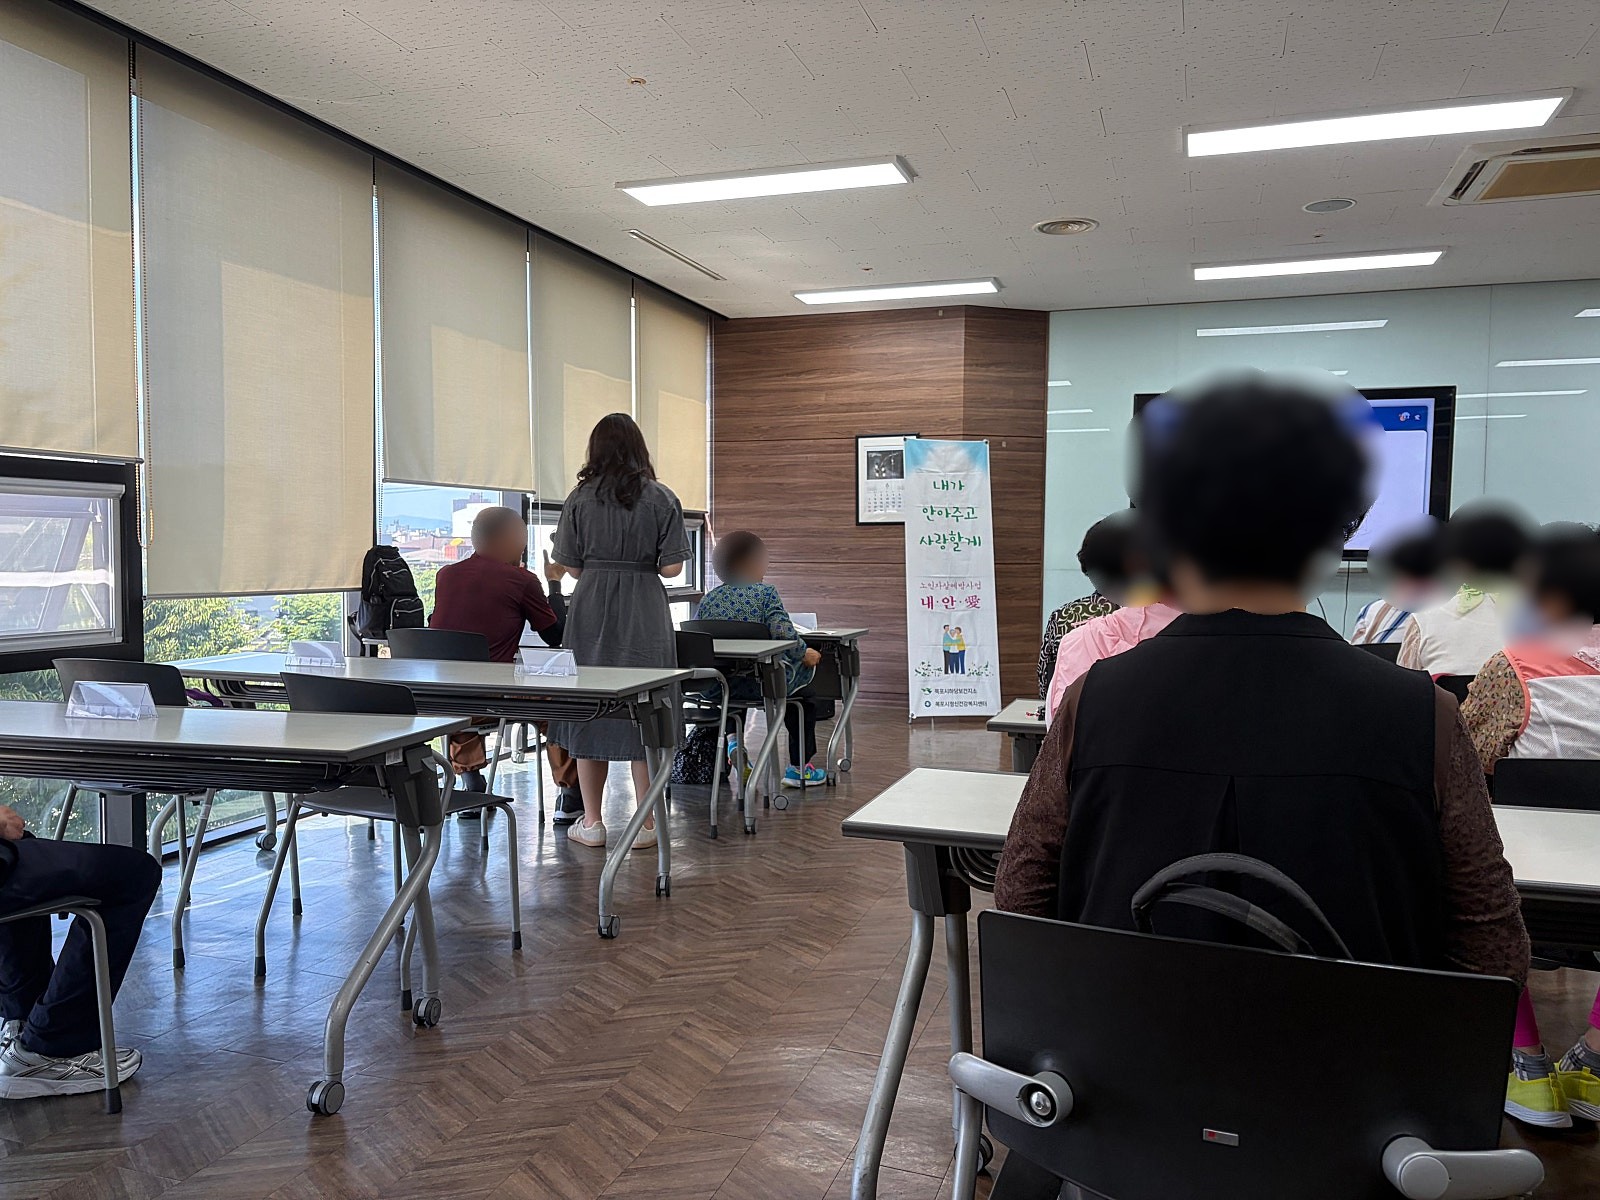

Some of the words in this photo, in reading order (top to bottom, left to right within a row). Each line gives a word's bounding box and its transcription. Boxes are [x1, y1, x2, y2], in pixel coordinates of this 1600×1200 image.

[933, 480, 965, 491] 내가
[922, 505, 978, 523] 안아주고
[919, 530, 982, 552] 사랑할게
